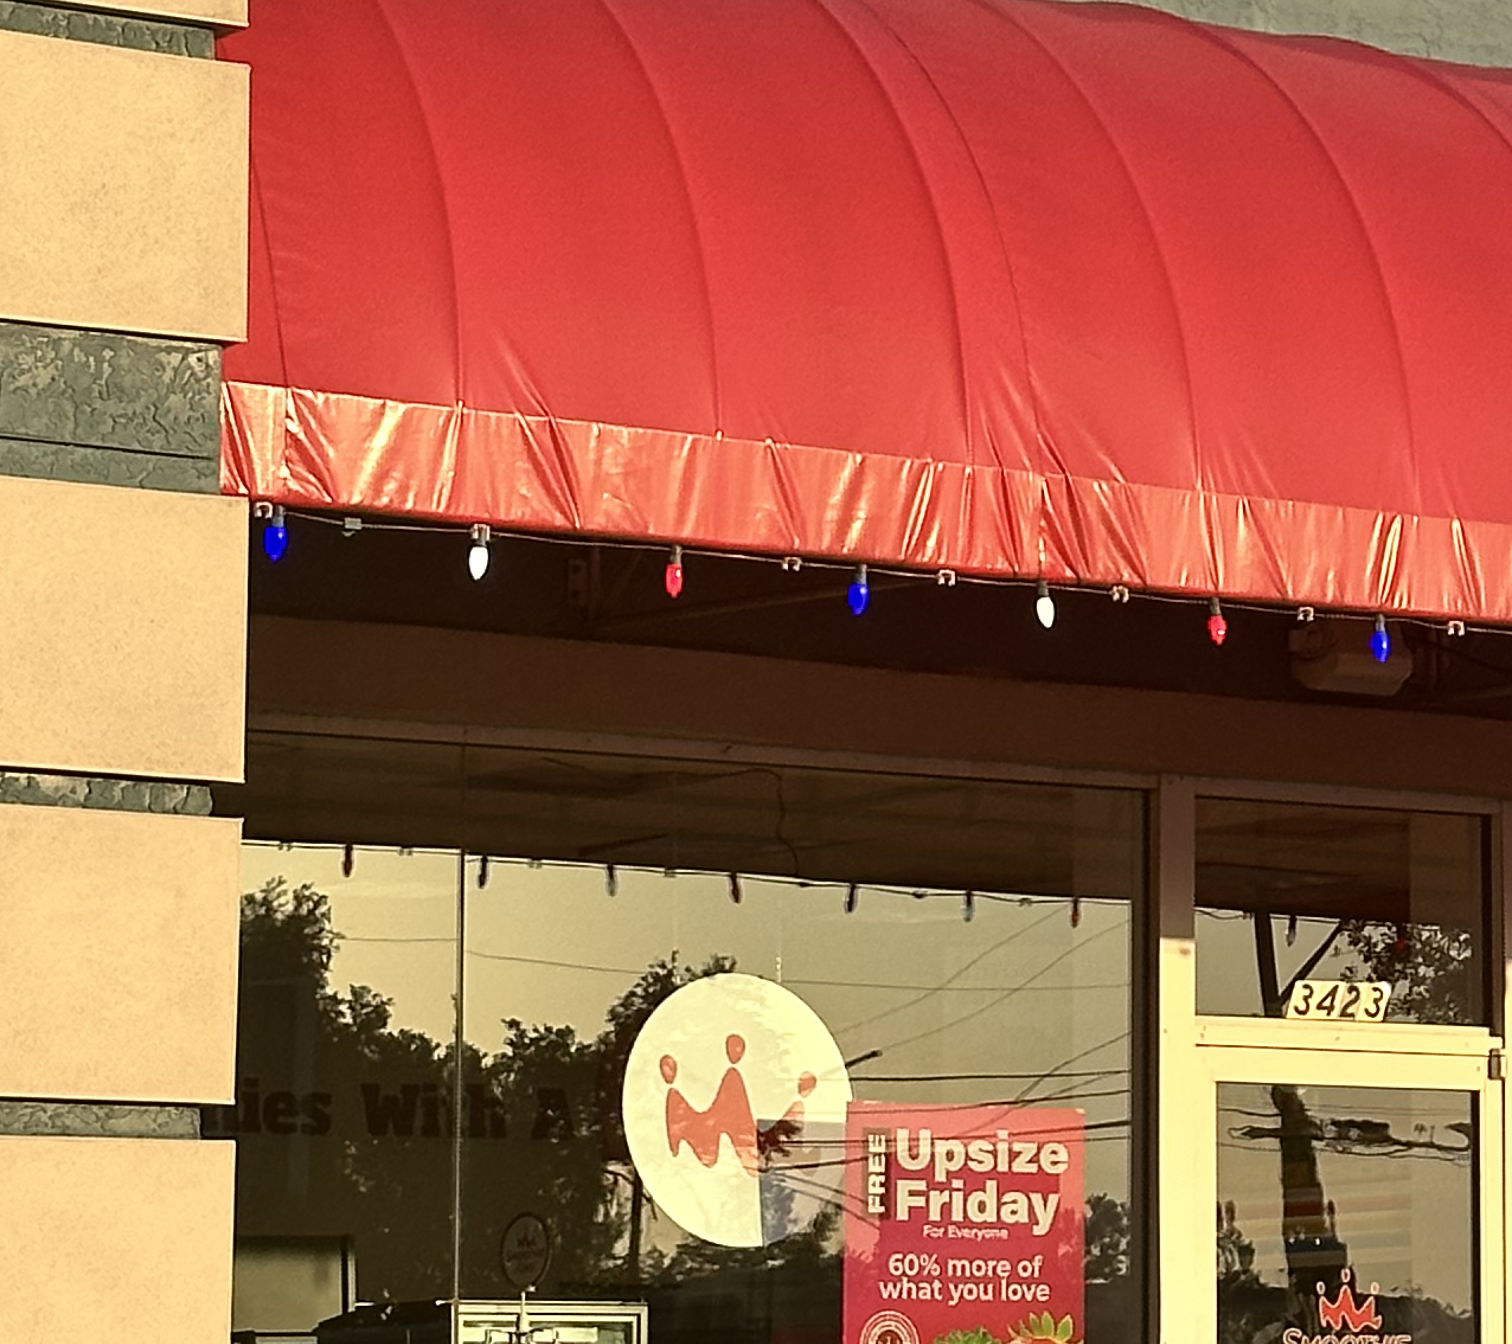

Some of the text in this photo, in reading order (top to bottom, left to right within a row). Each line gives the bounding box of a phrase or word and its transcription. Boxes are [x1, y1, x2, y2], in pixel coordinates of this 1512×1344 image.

[1293, 983, 1385, 1019] 3423
[222, 1076, 334, 1136] ies
[867, 1133, 887, 1214] FREE
[895, 1127, 1070, 1183] Upsize
[895, 1178, 1061, 1237] Friday
[922, 1224, 1010, 1243] For Everyone
[887, 1253, 1045, 1279] 60% more of
[878, 1276, 1051, 1306] what you love
